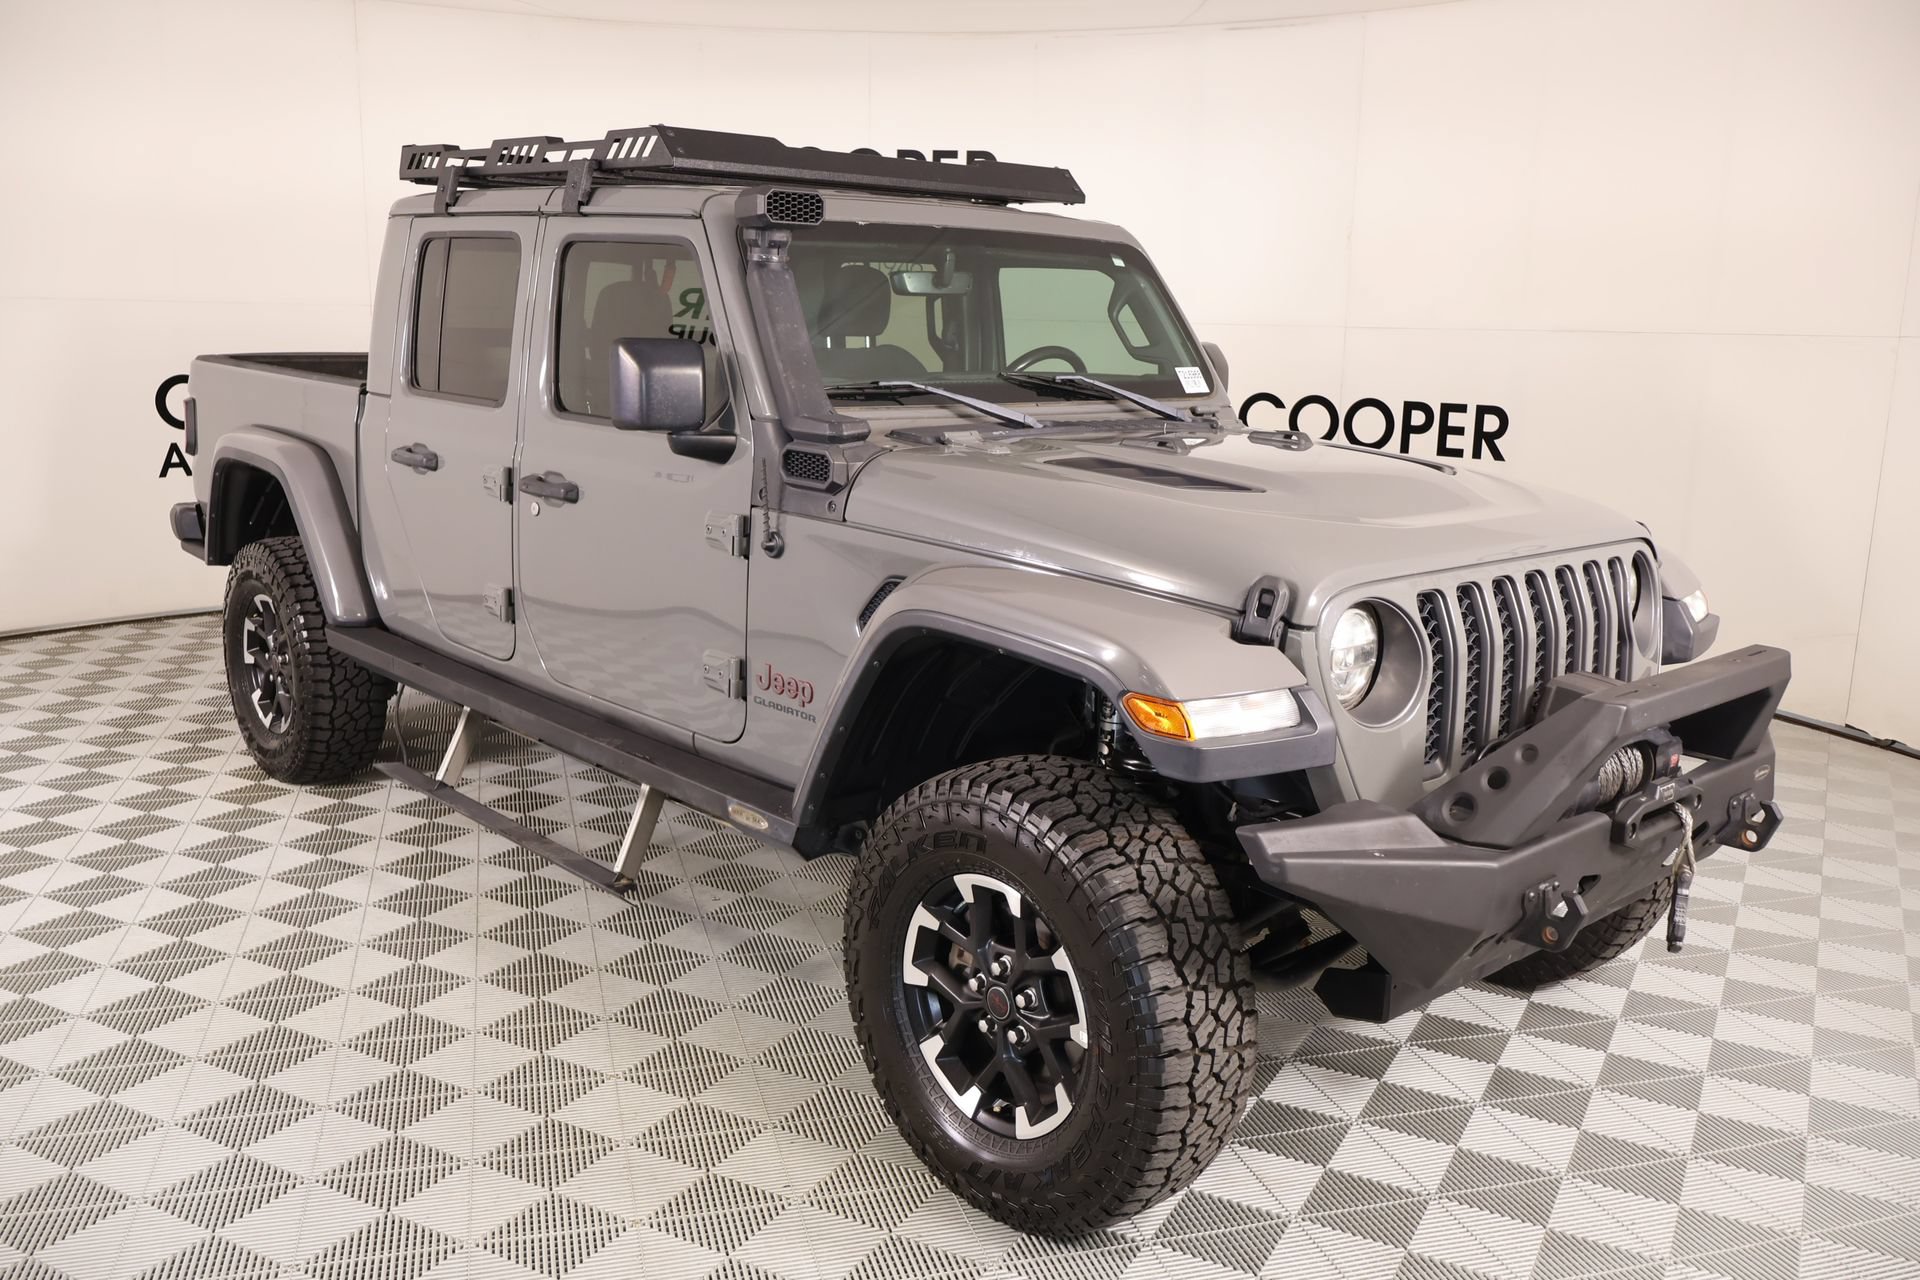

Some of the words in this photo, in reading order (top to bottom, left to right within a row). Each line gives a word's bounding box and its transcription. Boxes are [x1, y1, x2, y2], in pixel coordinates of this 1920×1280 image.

[1238, 392, 1510, 462] COOPER
[756, 663, 815, 708] Jeep
[753, 695, 817, 723] GLADIATOR
